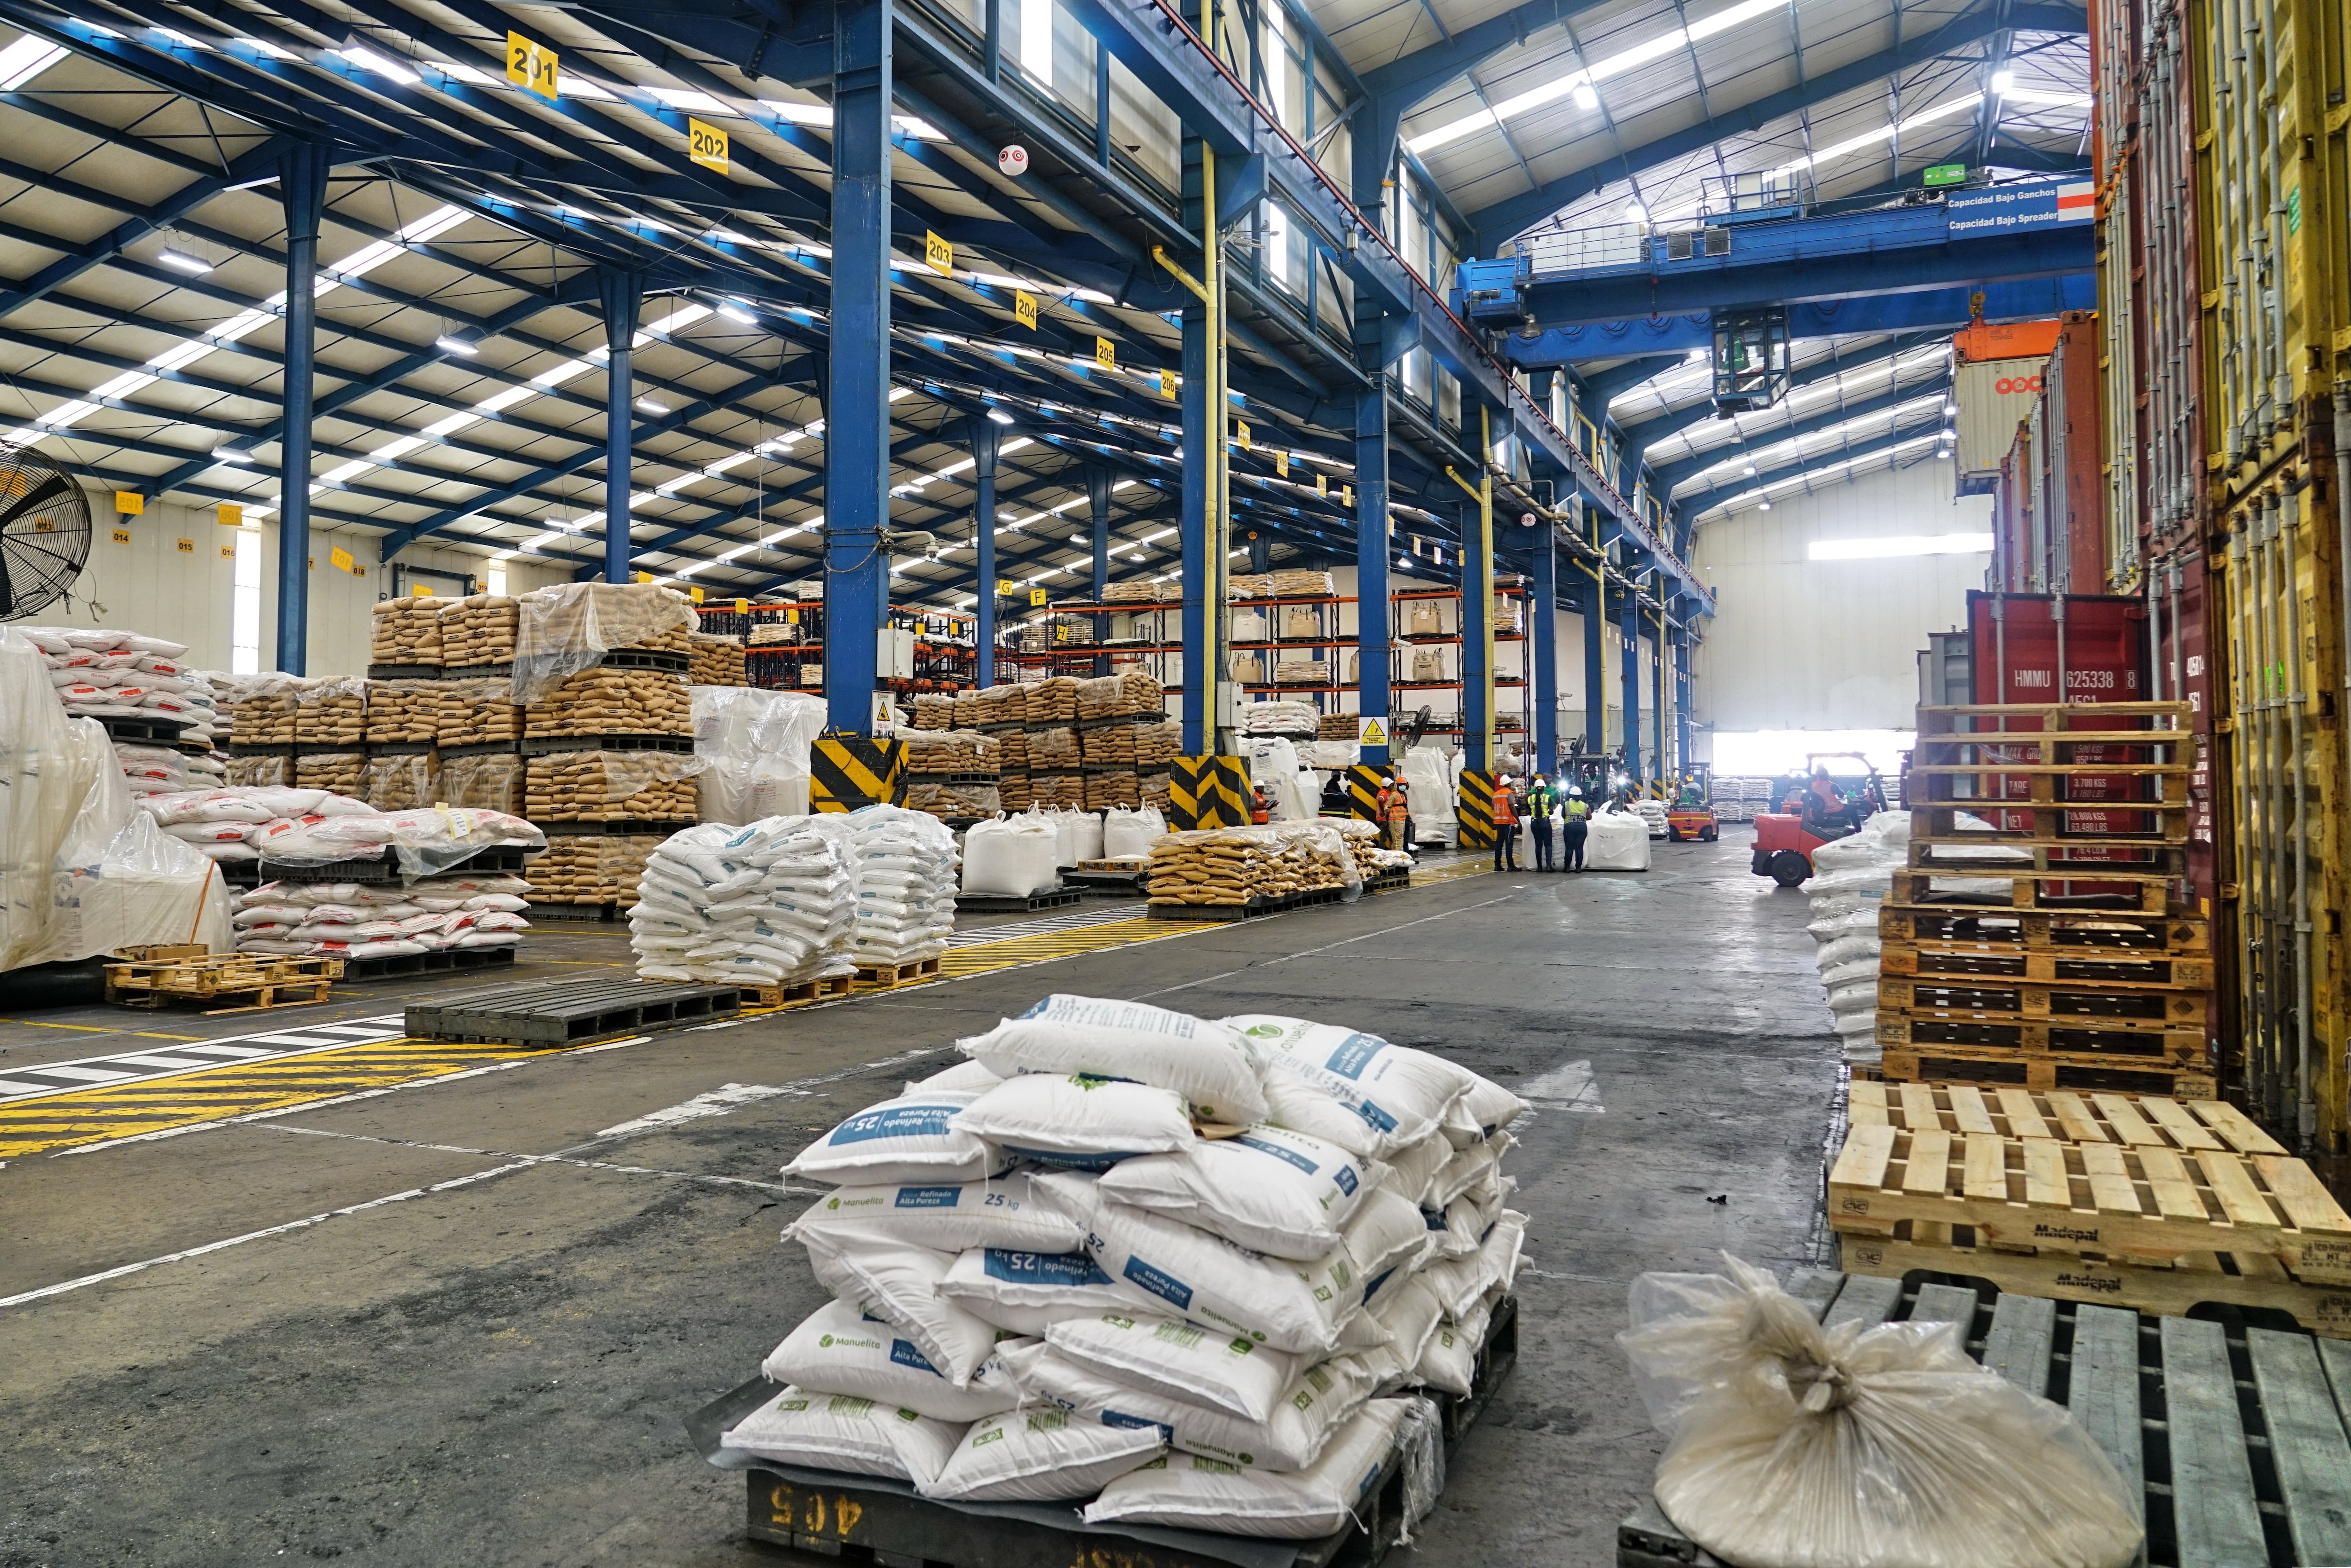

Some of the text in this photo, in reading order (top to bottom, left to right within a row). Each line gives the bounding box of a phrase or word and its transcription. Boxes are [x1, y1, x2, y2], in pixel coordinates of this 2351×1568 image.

[514, 47, 552, 86] 201
[694, 130, 724, 160] 202
[1948, 189, 2055, 208] Capacidad Bajo Ganchos
[1949, 212, 2058, 230] Capacidad Bajo Spreader
[929, 241, 950, 264] 203
[1018, 298, 1035, 321] 204
[1099, 345, 1113, 363] 205
[1162, 377, 1175, 392] 206
[1239, 427, 1249, 444] 207
[114, 533, 128, 543] 014
[179, 542, 192, 551] 015
[1002, 583, 1009, 593] G
[1035, 591, 1041, 604] F
[1057, 629, 1065, 638] H
[2015, 670, 2135, 688] HMMU 625338 8
[2091, 745, 2104, 753] KGS
[2009, 781, 2028, 793] TARE
[2074, 778, 2106, 788] 3.700 KGS
[2091, 789, 2106, 798] LBS
[2007, 815, 2022, 828] NET
[2068, 812, 2105, 820] 28.800 KGS
[2071, 823, 2107, 832] 63.490 LBS
[1344, 1062, 1354, 1073] Alta
[855, 1116, 879, 1132] 25
[884, 1117, 923, 1127] Refinado
[1265, 1146, 1291, 1157] 25
[843, 1197, 884, 1206] Manuelita
[984, 1193, 1020, 1210] 25 kg
[2034, 1224, 2099, 1242] Madepal
[1087, 1232, 1105, 1253] 25
[995, 1250, 1036, 1270] 25 kg
[1132, 1271, 1166, 1296] Refinado
[1144, 1269, 1188, 1299] Alta Pureza
[2056, 1273, 2122, 1293] Madepal
[1200, 1306, 1250, 1335] Manuelita
[835, 1337, 881, 1349] Manuelita
[894, 1350, 929, 1366] Alta Pure
[974, 1361, 1002, 1377] 5 kg
[1041, 1389, 1076, 1411] 25 kg
[1184, 1439, 1236, 1458] Manuelita
